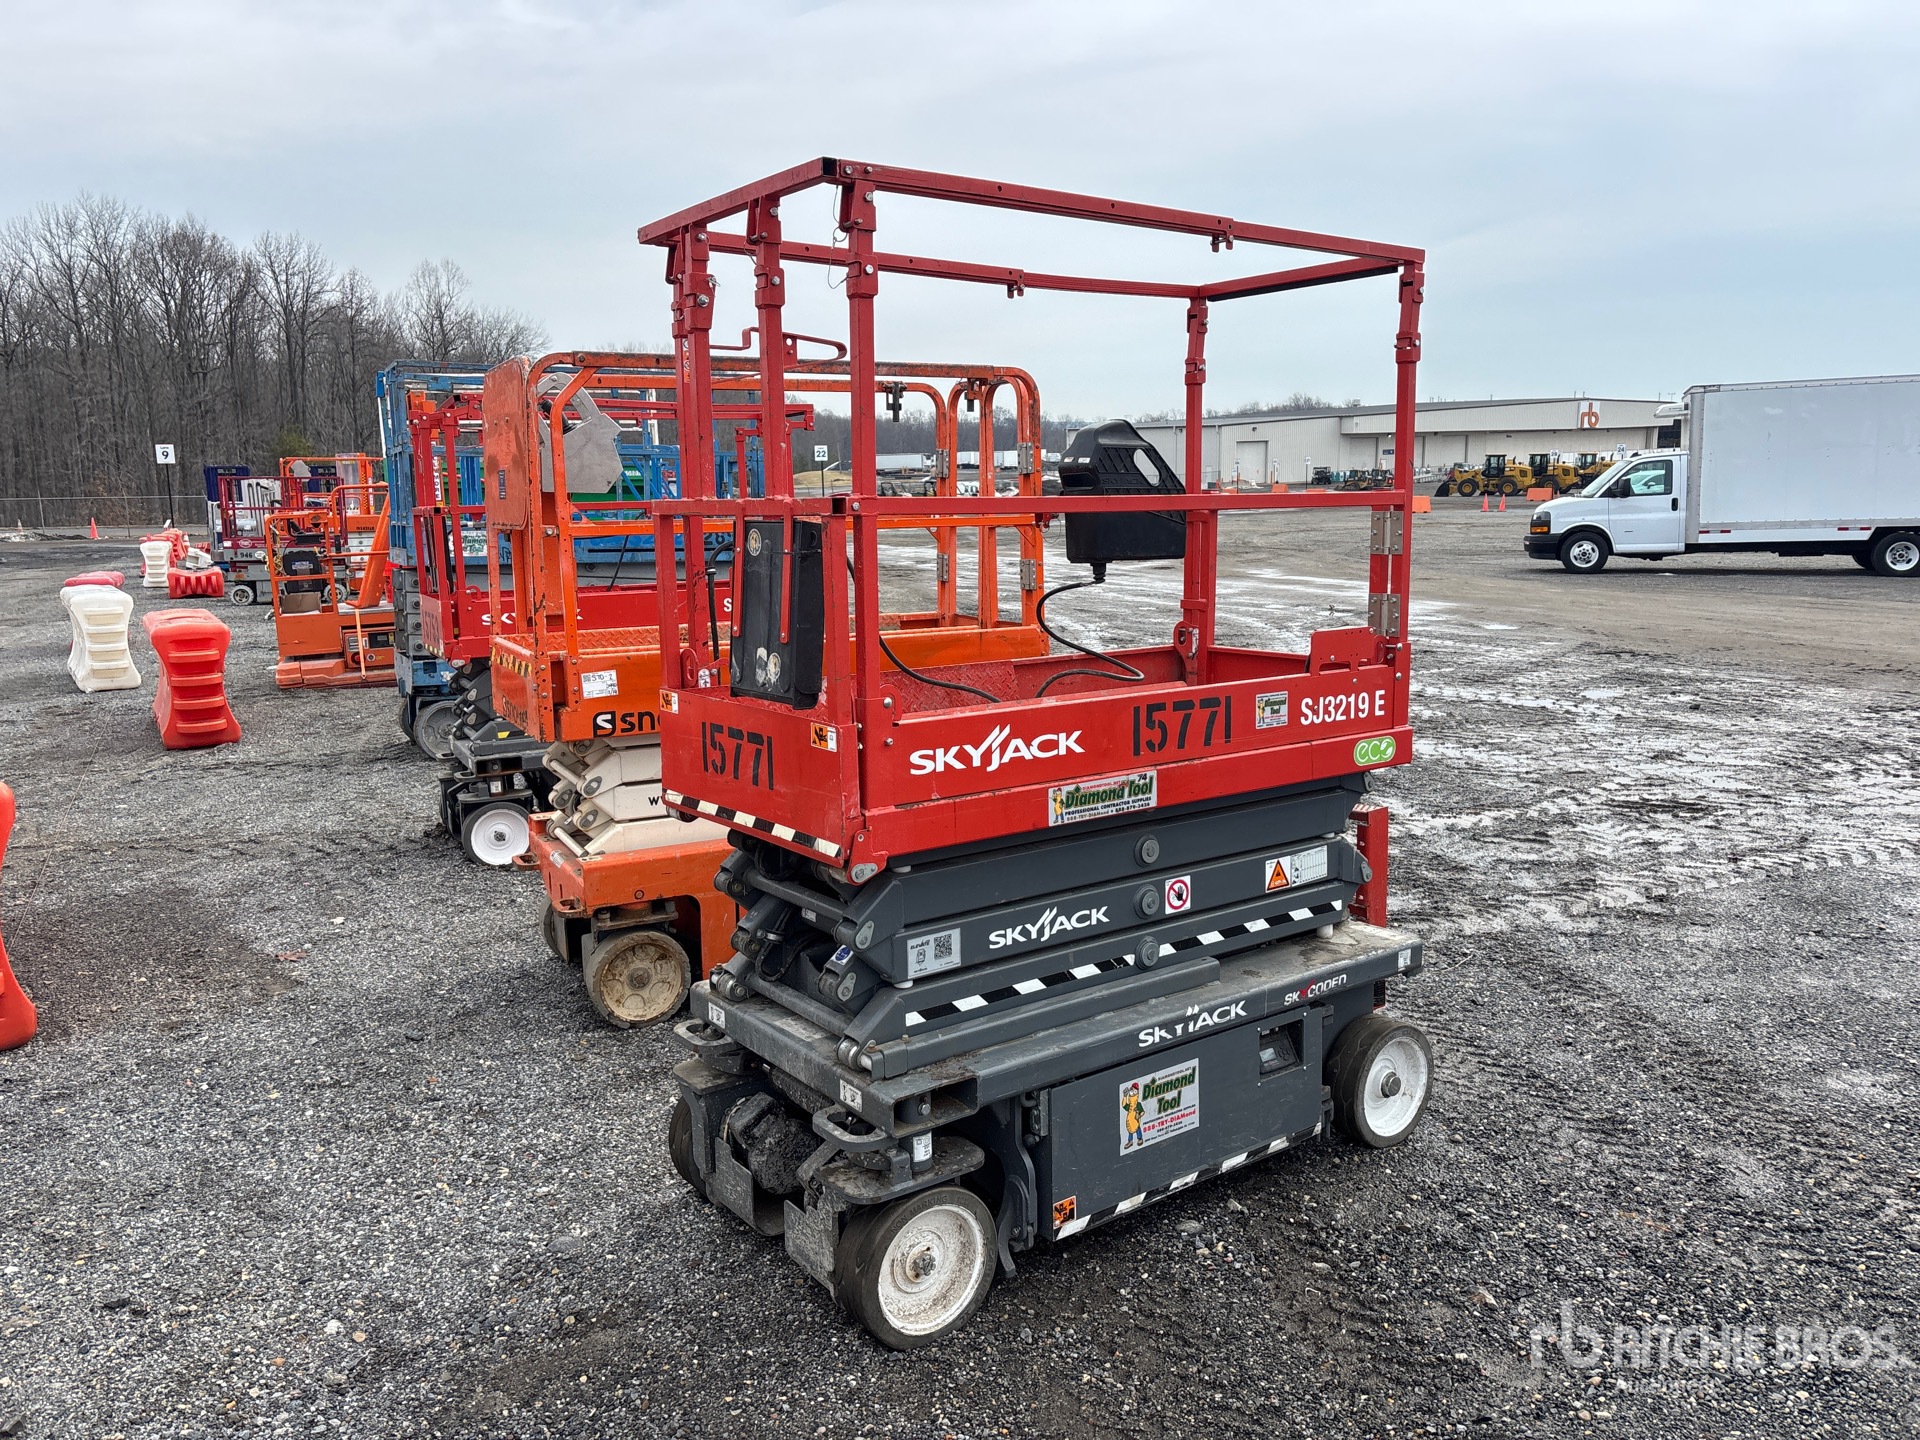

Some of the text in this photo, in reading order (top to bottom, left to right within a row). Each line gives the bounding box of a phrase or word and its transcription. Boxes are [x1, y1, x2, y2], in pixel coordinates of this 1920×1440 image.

[1581, 402, 1599, 428] rb
[161, 450, 169, 459] 9
[1300, 689, 1386, 725] SJ3219 E
[1132, 695, 1232, 757] 15771
[701, 721, 774, 791] 15771
[909, 723, 1086, 775] SKYJACK
[1064, 796, 1152, 816] PROFESSIONAL CONTRACTOR SUPPLIES
[1065, 775, 1155, 809] Diamond Tool
[988, 905, 1110, 949] SKYJACK
[1142, 1065, 1197, 1102] Diamond
[1157, 1089, 1183, 1115] Tool
[1143, 1108, 1197, 1133] 888-TRY-DIAMond
[909, 1195, 949, 1215] MARKING
